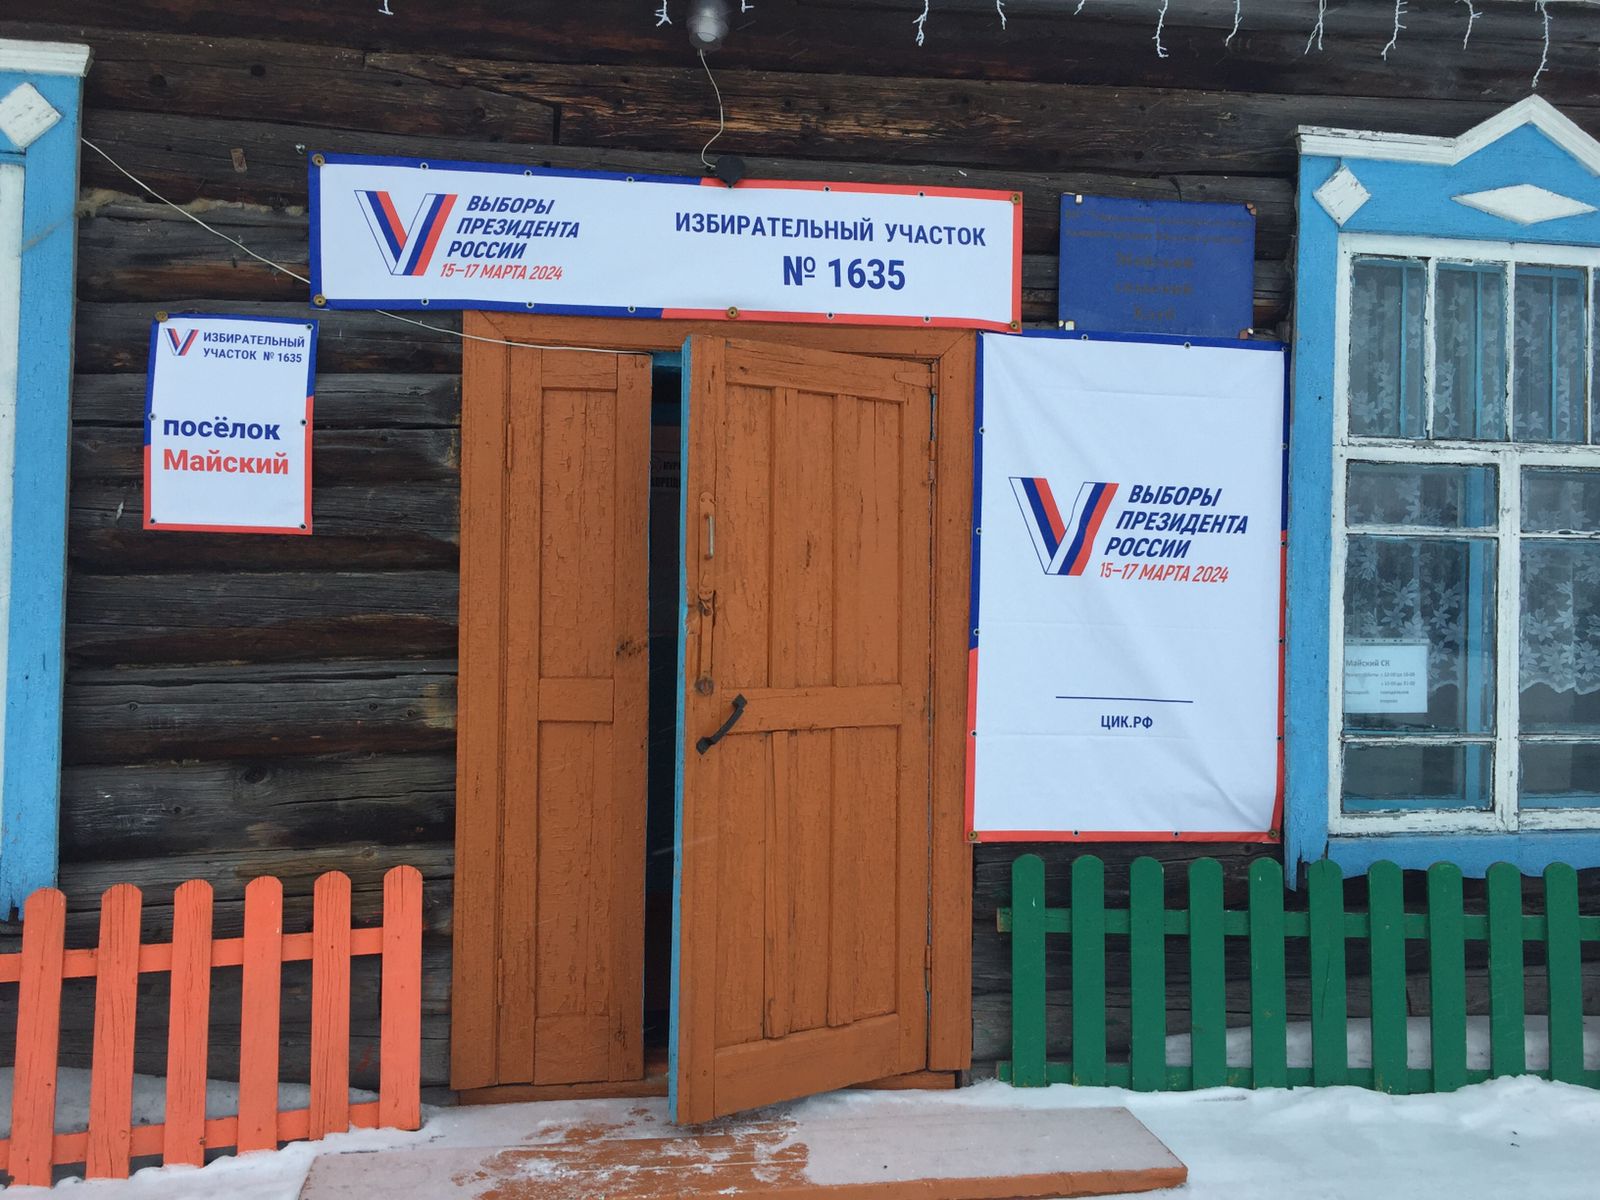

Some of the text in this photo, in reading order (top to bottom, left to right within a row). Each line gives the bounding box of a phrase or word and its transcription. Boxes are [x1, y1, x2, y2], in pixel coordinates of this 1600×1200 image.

[466, 195, 556, 215] ВЫБОРЫ
[456, 217, 580, 239] ПРЕЗИДЕНТА
[675, 211, 987, 247] ИЗБИРАТЕЛЬНЫЙ УЧАСТОК
[447, 240, 527, 260] РОССИИ
[480, 264, 527, 280] МАРТА
[528, 265, 563, 281] 2024
[783, 255, 906, 291] № 1635
[203, 331, 305, 348] ИЗБИРАТЕЛЬНЫЙ
[203, 347, 303, 363] УЧАСТОК № 1635
[163, 415, 281, 441] посёлок
[163, 448, 289, 475] Майский
[1128, 484, 1222, 507] ВЫБОРЫ
[1115, 510, 1249, 535] ПРЕЗИДЕНТА
[1104, 536, 1191, 559] РОССИИ
[1139, 563, 1191, 582] МАРТА
[1192, 565, 1229, 583] 2024
[1101, 714, 1154, 731] ЦИК.РФ
